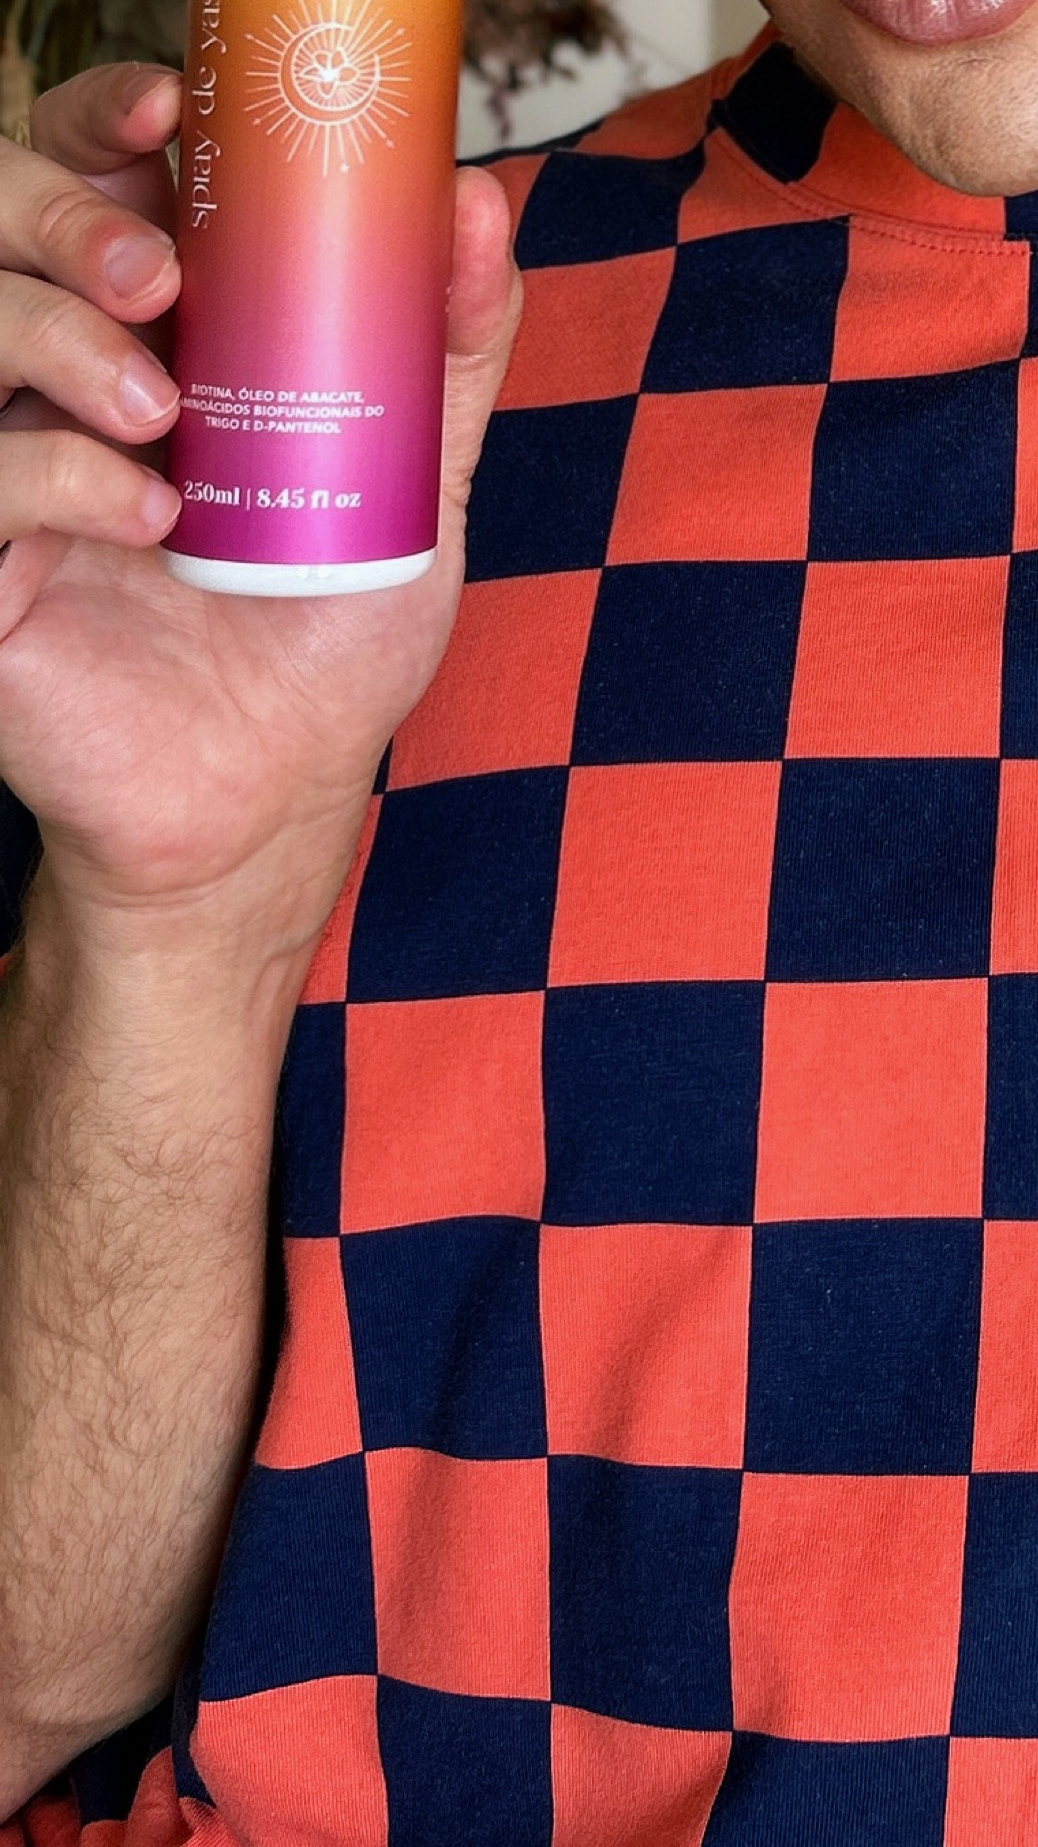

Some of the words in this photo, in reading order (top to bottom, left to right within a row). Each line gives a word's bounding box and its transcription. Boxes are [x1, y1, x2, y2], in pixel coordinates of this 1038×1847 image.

[192, 66, 217, 115] de
[192, 130, 221, 229] spray
[238, 386, 275, 402] ÓLEO
[277, 390, 297, 403] DE
[253, 404, 362, 419] BIOFUNCIONAIS
[364, 405, 385, 418] DO
[205, 415, 240, 431] TRIGO
[242, 419, 252, 431] E
[253, 420, 342, 434] D-PANTENOL
[183, 480, 240, 505] 250ml
[257, 487, 305, 509] 8.45
[311, 489, 330, 509] fl
[335, 491, 362, 508] oz
